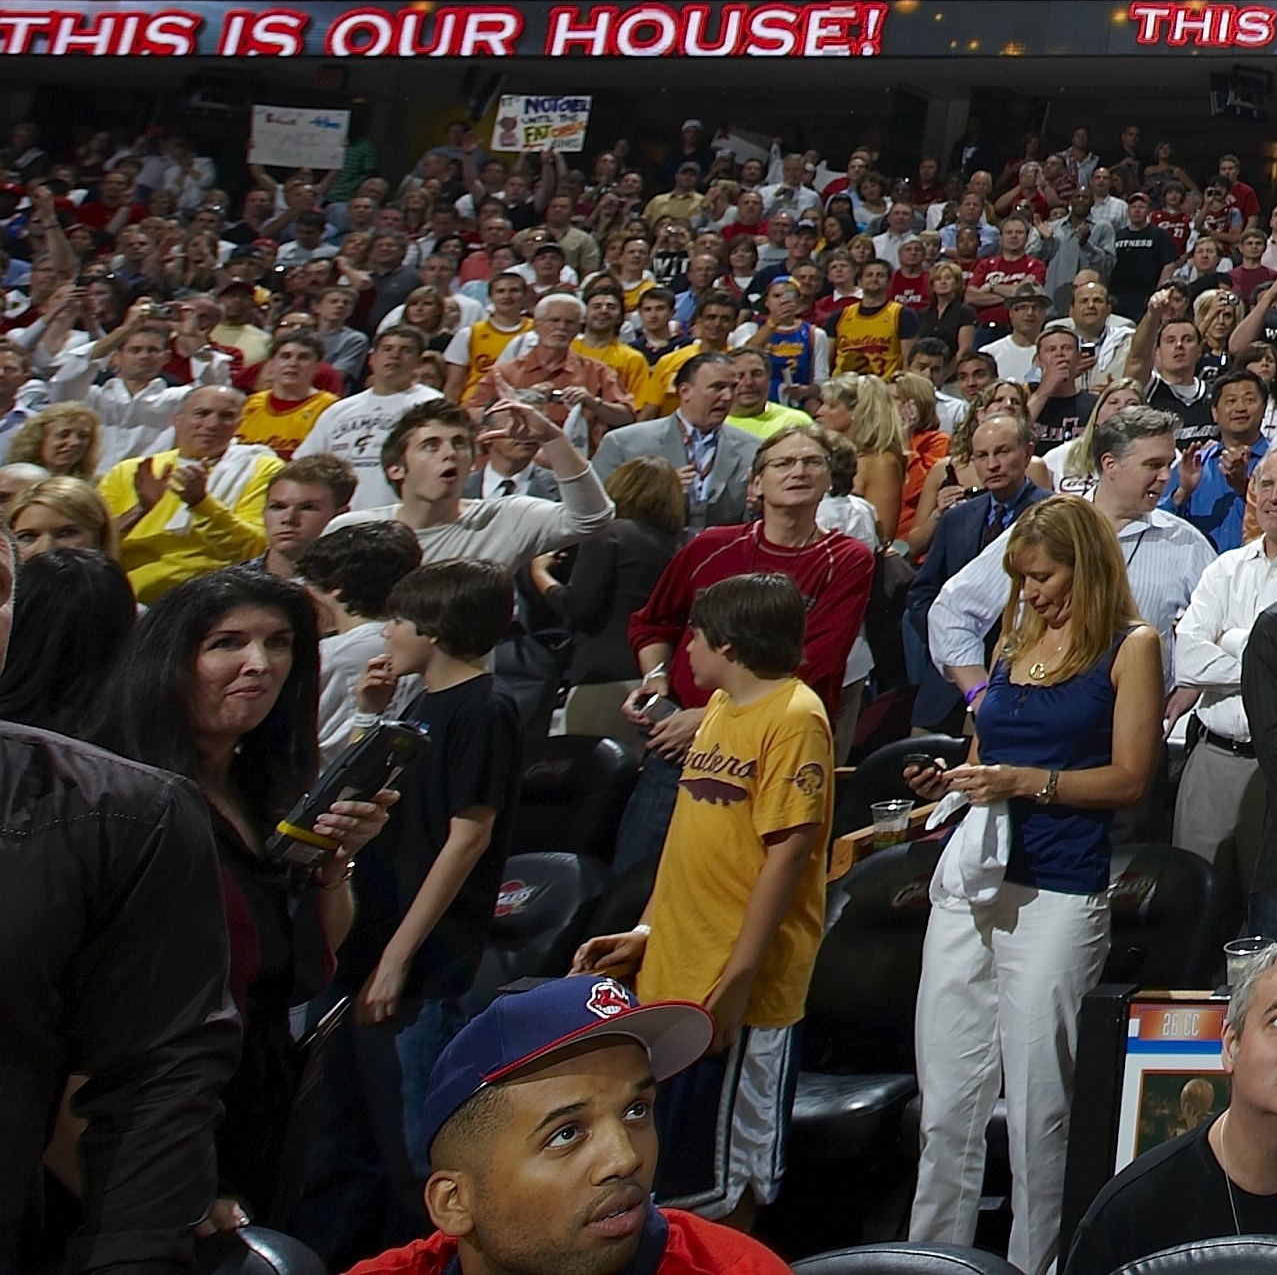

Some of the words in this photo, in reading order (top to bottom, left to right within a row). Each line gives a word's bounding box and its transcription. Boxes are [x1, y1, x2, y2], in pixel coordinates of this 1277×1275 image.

[0, 14, 195, 56] THIS
[224, 12, 307, 56] IS
[332, 8, 519, 56] OUR
[550, 4, 887, 57] HOUSE!
[1133, 6, 1271, 46] THIS
[1161, 1013, 1181, 1037] 26
[1183, 1013, 1200, 1037] CC
